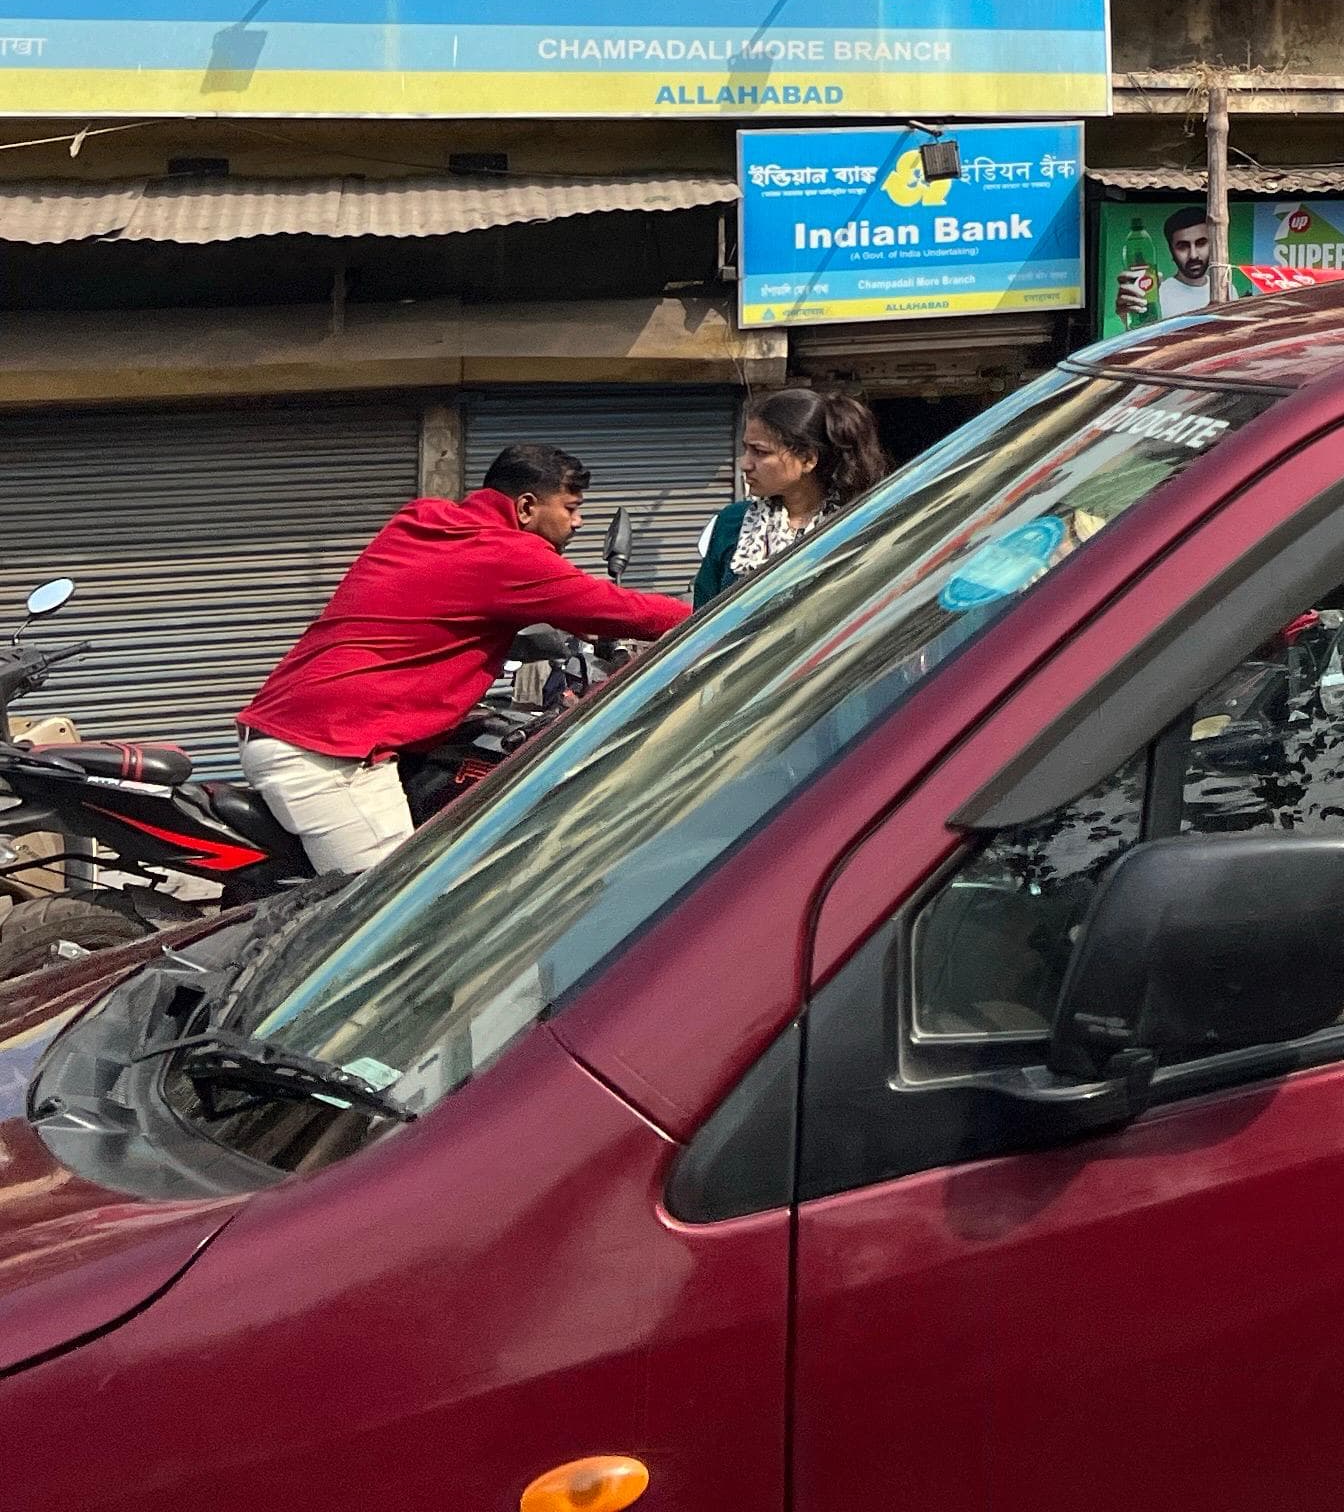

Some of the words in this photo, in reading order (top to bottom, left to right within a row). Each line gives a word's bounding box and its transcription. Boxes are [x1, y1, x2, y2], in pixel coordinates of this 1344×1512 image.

[538, 39, 736, 62] CHAMPADALI
[741, 40, 826, 61] MORE
[833, 41, 952, 62] BRANCH
[655, 85, 844, 106] ALLAHABAD
[795, 220, 919, 250] Indian
[934, 213, 1033, 244] Bank
[899, 250, 920, 259] India
[922, 246, 980, 258] Undertaking)
[858, 277, 913, 291] Champadali
[916, 277, 940, 288] More
[942, 274, 976, 286] Branch
[885, 301, 950, 311] ALLAHABAD
